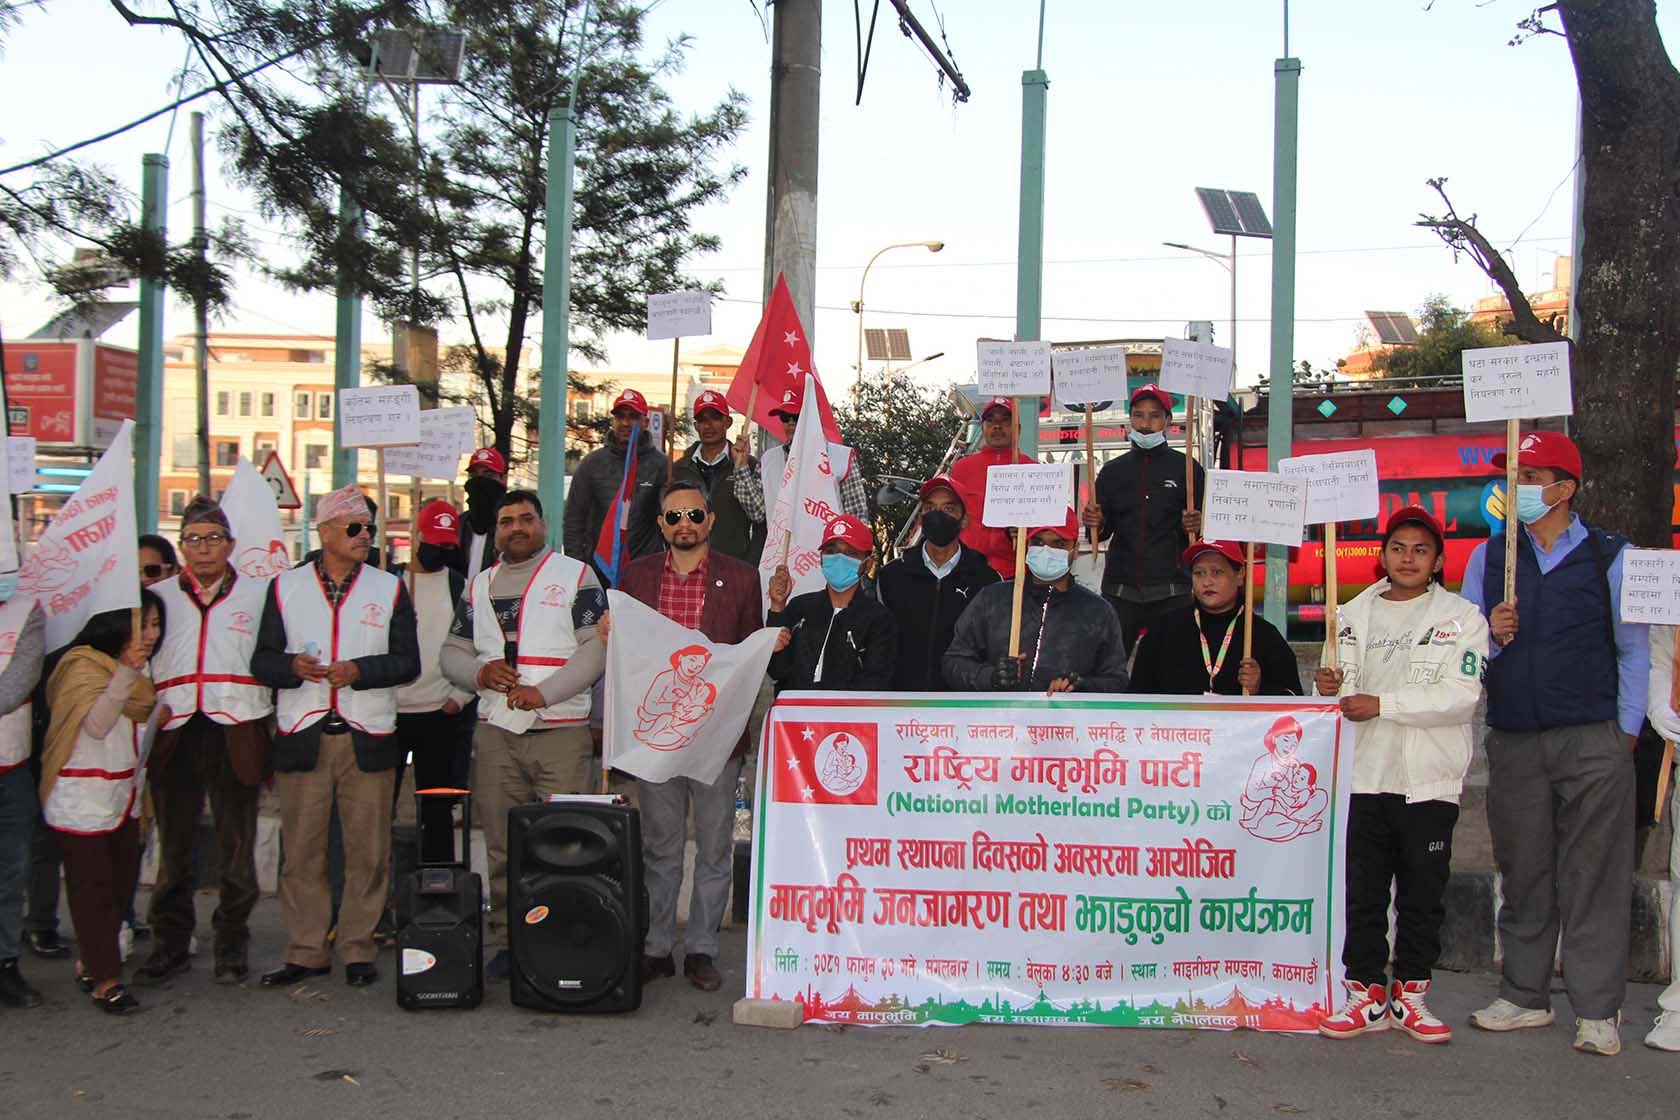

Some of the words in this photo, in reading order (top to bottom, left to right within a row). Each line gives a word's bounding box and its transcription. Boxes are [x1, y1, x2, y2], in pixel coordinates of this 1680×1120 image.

[1461, 650, 1478, 677] 8
[895, 718, 959, 744] राष्ट्रियता,
[1026, 724, 1079, 745] सुशासन,
[1088, 721, 1127, 747] समृद्धि
[1133, 726, 1144, 745] र
[1151, 723, 1216, 746] नेपालवाद
[903, 745, 1001, 791] राष्ट्रिय
[1010, 748, 1129, 794] मातृभूमि
[1139, 750, 1204, 788] पार्टी
[886, 792, 988, 817] (National
[995, 794, 1121, 818] Motherland
[1128, 797, 1200, 826] Party)
[1206, 799, 1233, 822] को
[845, 837, 892, 870] प्रथम
[897, 838, 967, 871] स्थापना
[973, 830, 1048, 873] दिवसको
[1053, 843, 1140, 877] अवसरमा
[1145, 837, 1238, 879] आयोजित
[769, 873, 866, 935] मातृभूमि
[873, 887, 1012, 930] जनजागरण
[1018, 891, 1068, 932] तथा
[1075, 886, 1193, 946] झाडुकुचो
[1200, 886, 1315, 936] कार्यक्रम
[775, 947, 799, 973] मिति
[814, 953, 840, 977] २०८१
[987, 960, 1012, 981] समय
[1026, 958, 1058, 988] बेलुका
[1062, 964, 1090, 985] ४:३०
[1095, 959, 1113, 981] बजे
[1131, 963, 1157, 981] स्थान
[1173, 955, 1221, 981] माइतीघर
[1272, 958, 1319, 985] काठमाडौं
[1172, 1012, 1238, 1027] नेपालवाद
